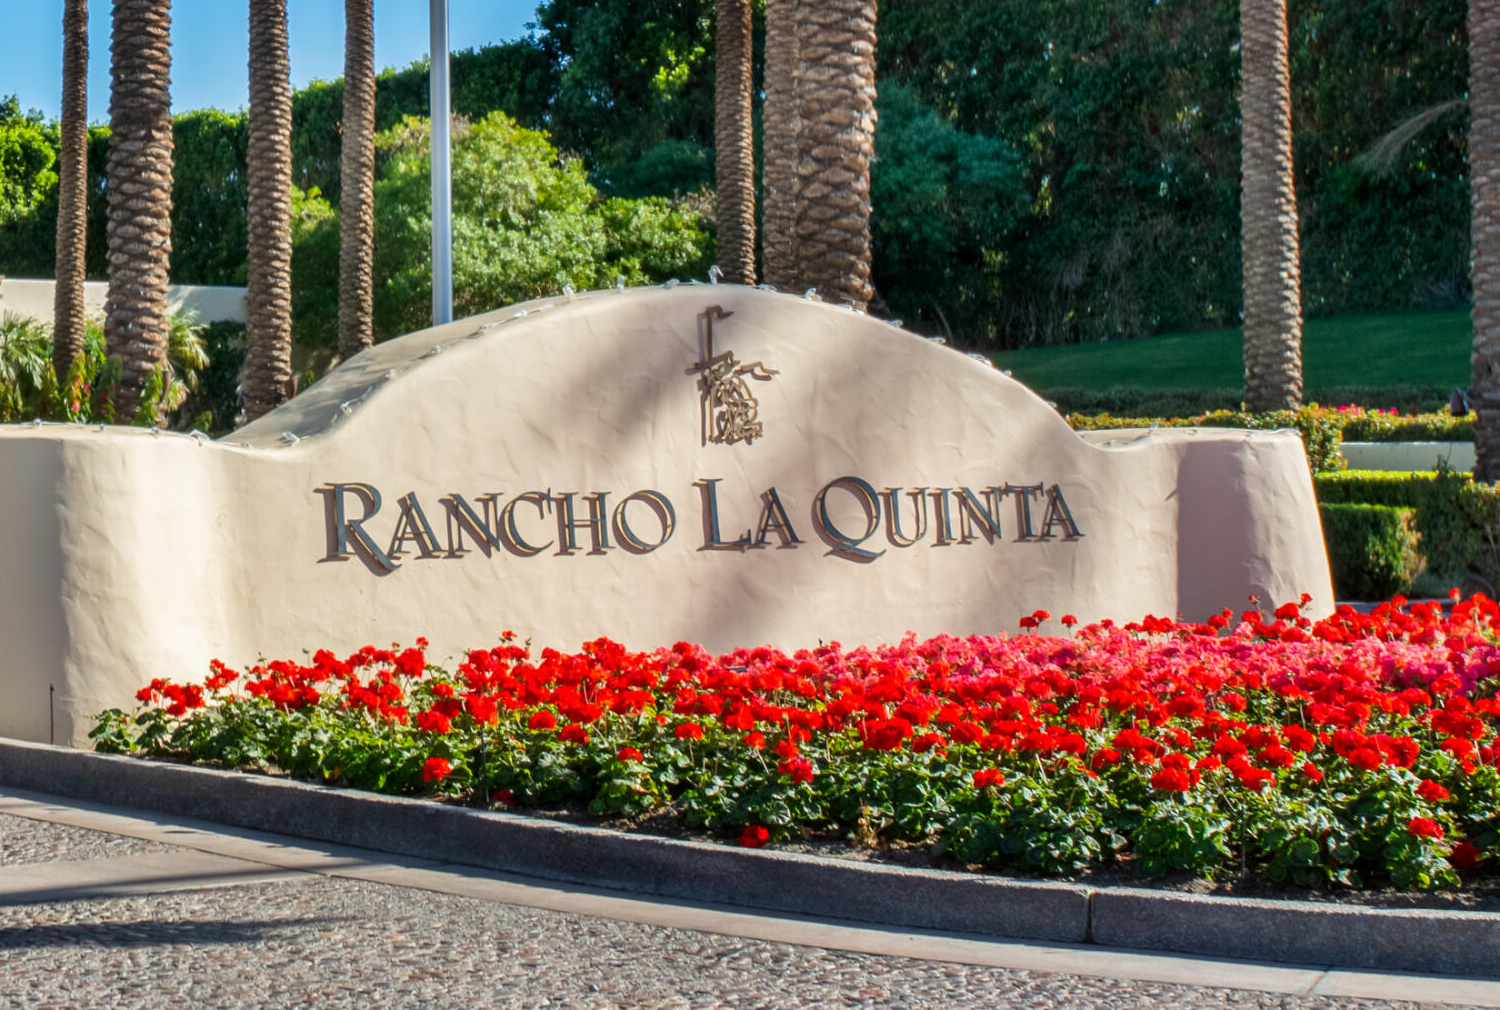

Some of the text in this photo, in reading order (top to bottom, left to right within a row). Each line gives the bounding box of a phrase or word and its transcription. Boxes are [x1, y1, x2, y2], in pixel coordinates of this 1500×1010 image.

[316, 475, 1086, 575] RANCHO LA QUINTA
